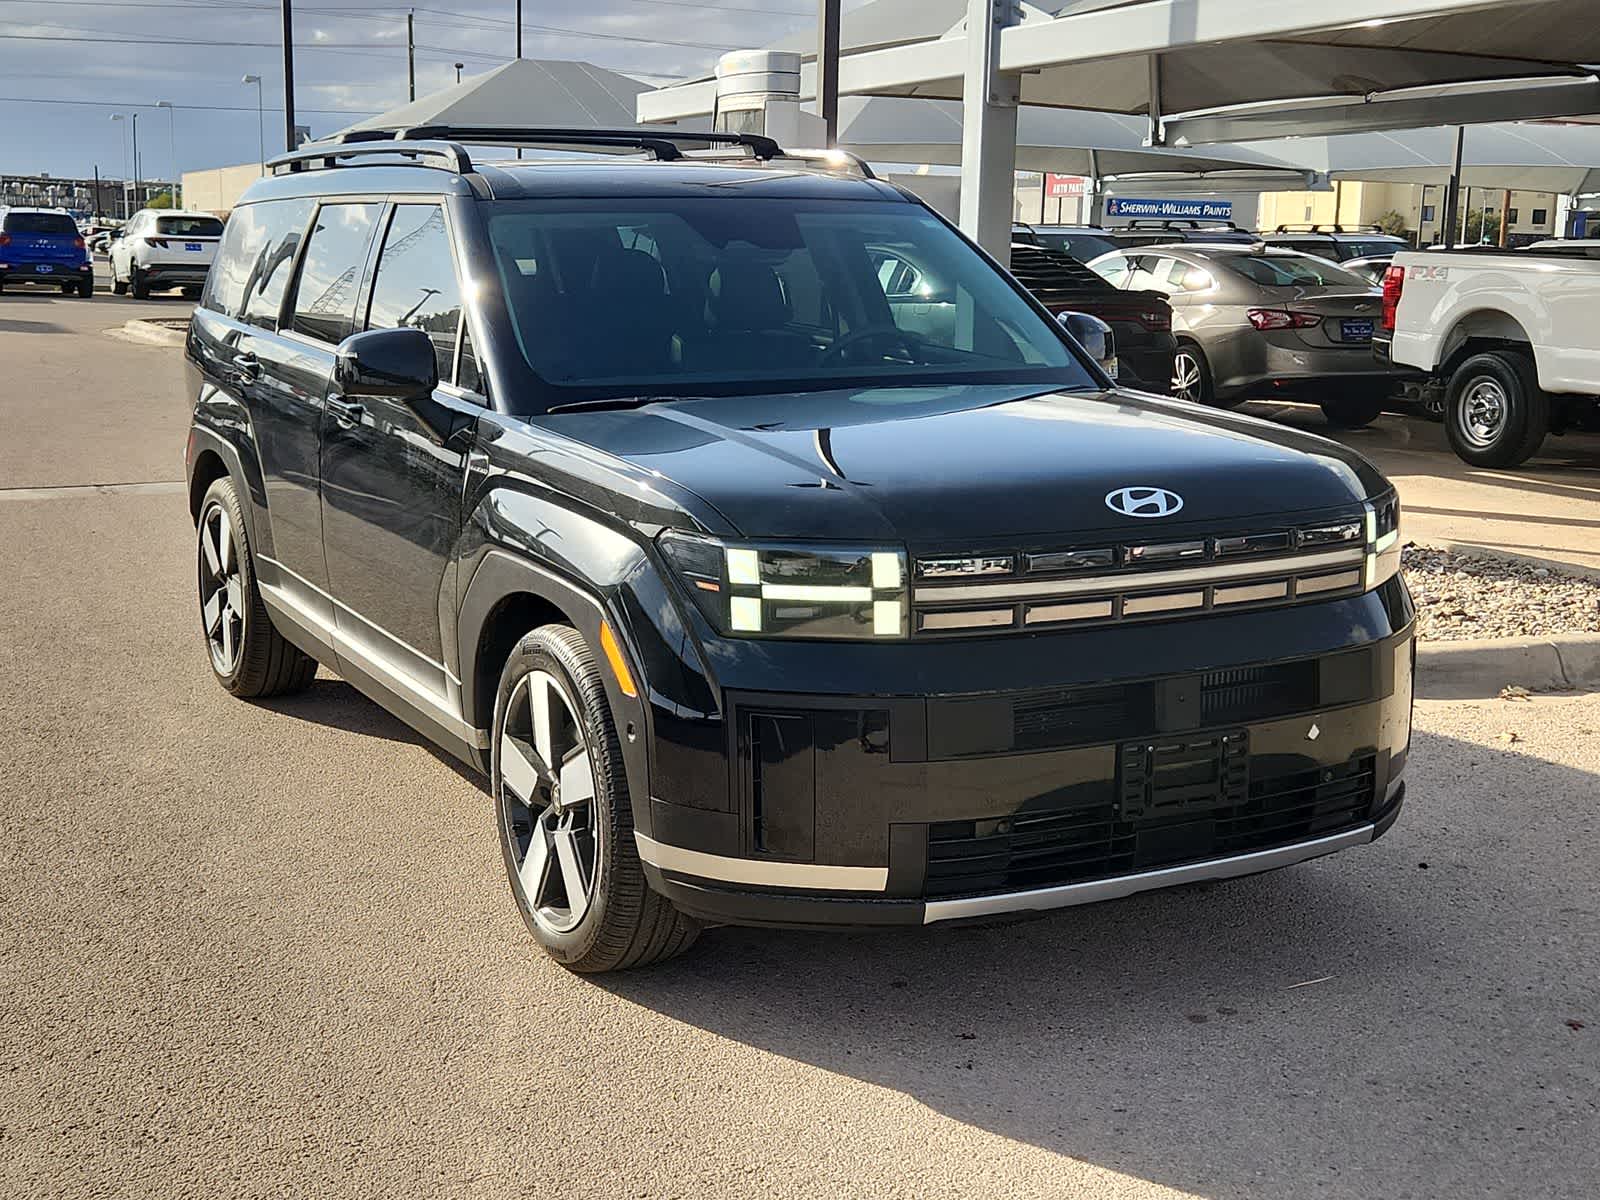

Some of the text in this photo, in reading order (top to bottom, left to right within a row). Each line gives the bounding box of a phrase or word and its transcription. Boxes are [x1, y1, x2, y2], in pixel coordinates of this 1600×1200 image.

[1120, 202, 1231, 216] SHERWIN-WILLIAMS PAINTS
[1408, 265, 1447, 280] FX4
